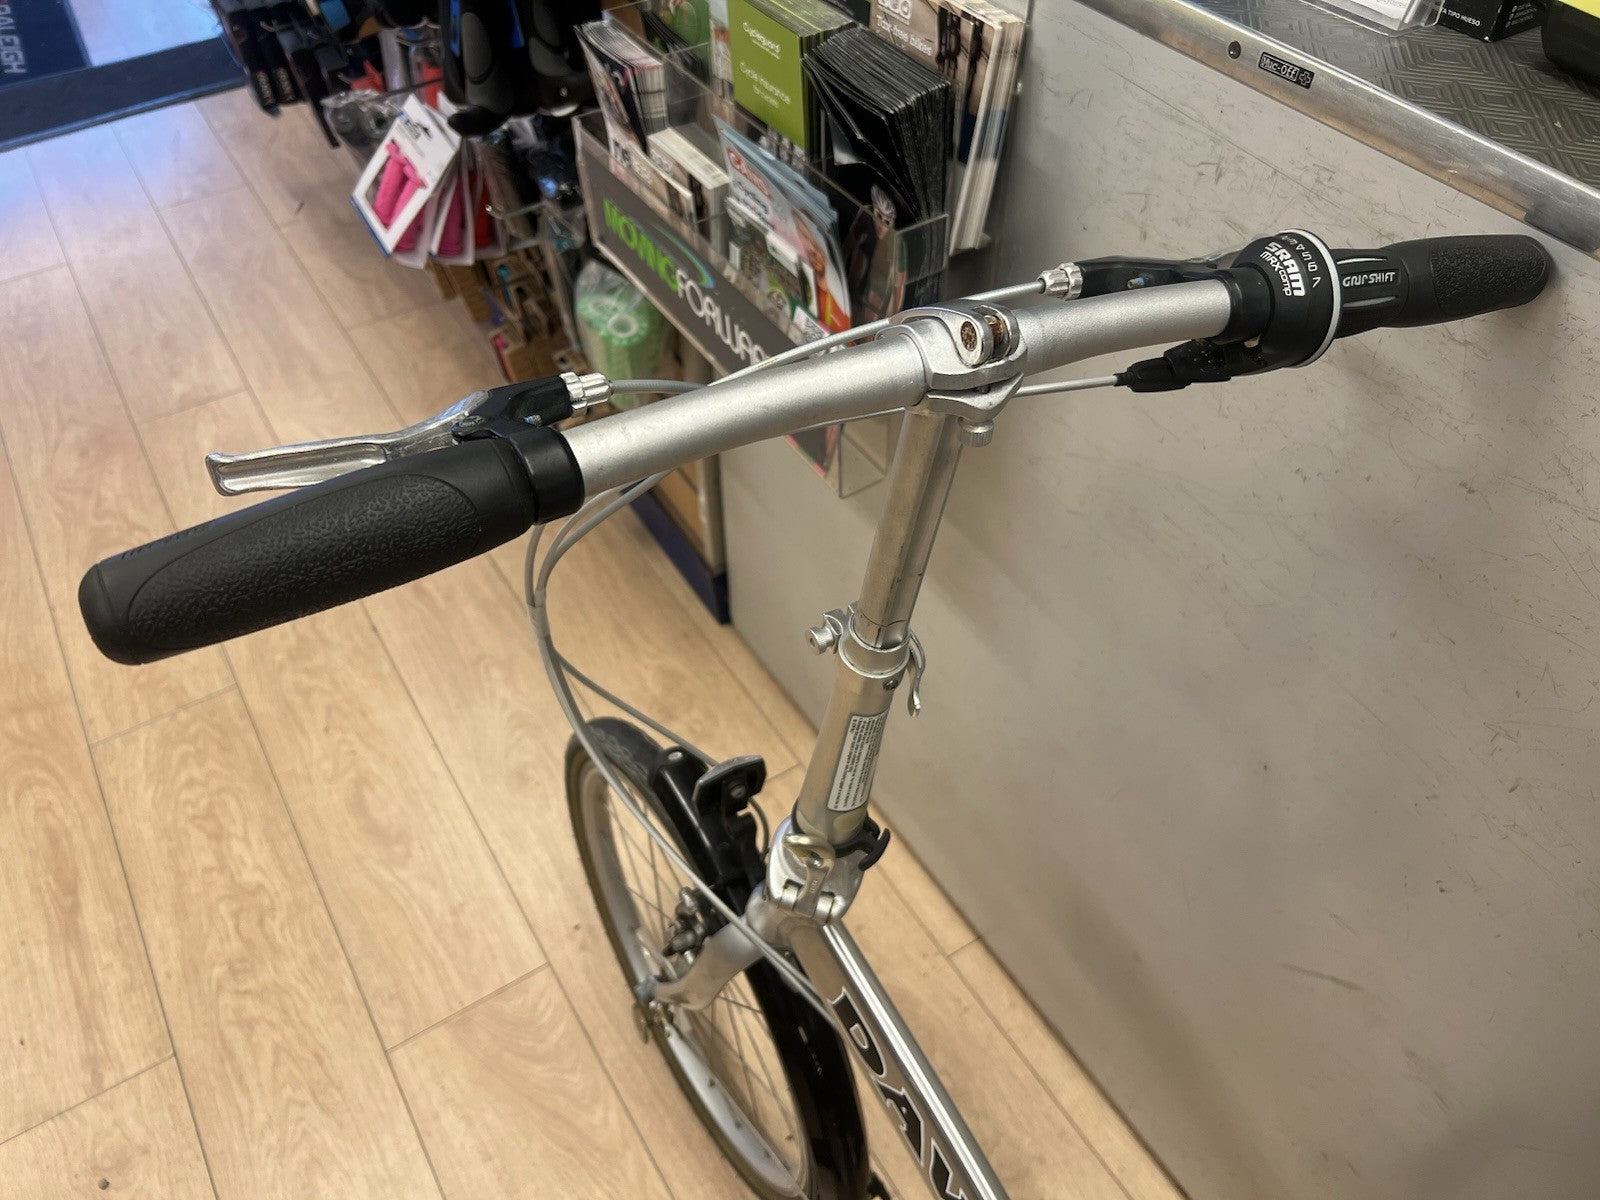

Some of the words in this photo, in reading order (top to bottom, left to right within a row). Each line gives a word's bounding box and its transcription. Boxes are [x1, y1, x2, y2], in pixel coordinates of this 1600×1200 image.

[1261, 56, 1298, 80] Muc-Off
[1295, 243, 1305, 251] 4
[1259, 251, 1283, 272] MRX
[1302, 251, 1312, 261] 5
[1264, 241, 1306, 297] SRAM
[1307, 263, 1318, 272] 6
[1312, 276, 1321, 288] 7
